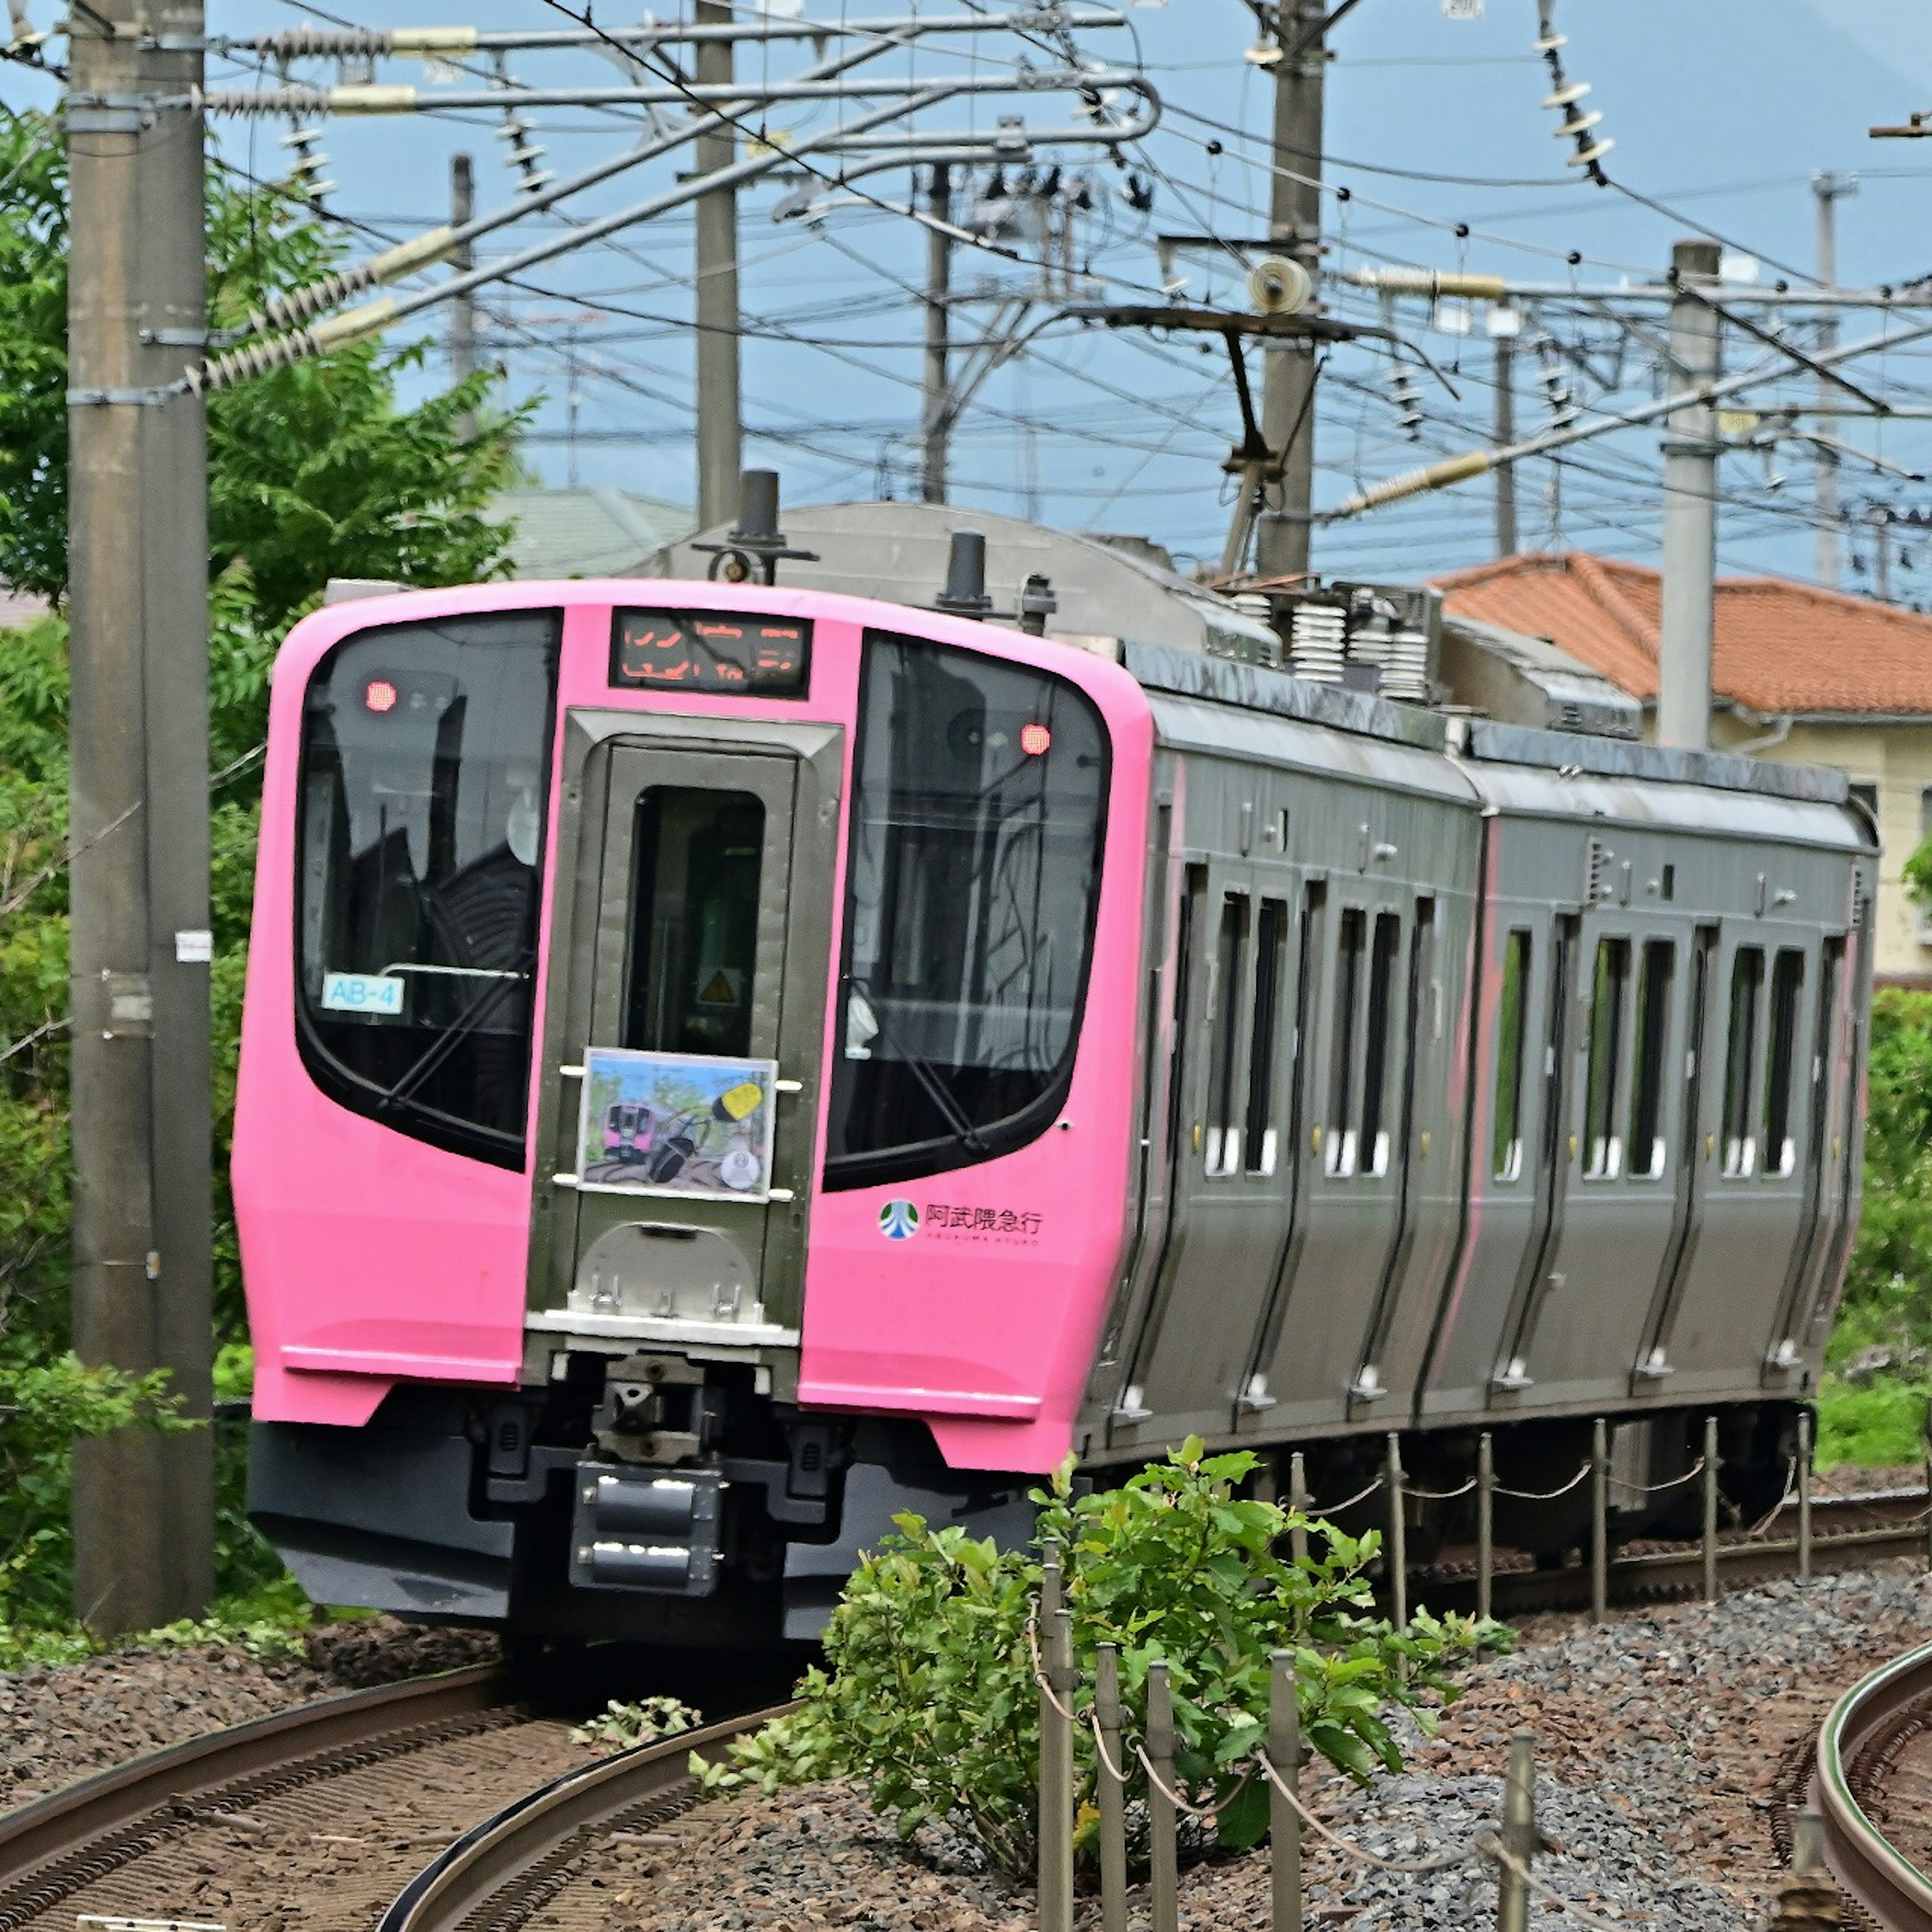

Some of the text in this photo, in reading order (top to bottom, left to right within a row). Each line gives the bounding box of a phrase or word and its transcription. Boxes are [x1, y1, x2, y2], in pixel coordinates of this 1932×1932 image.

[331, 981, 393, 1005] AB-4
[926, 1204, 1043, 1234] 阿武隈急行
